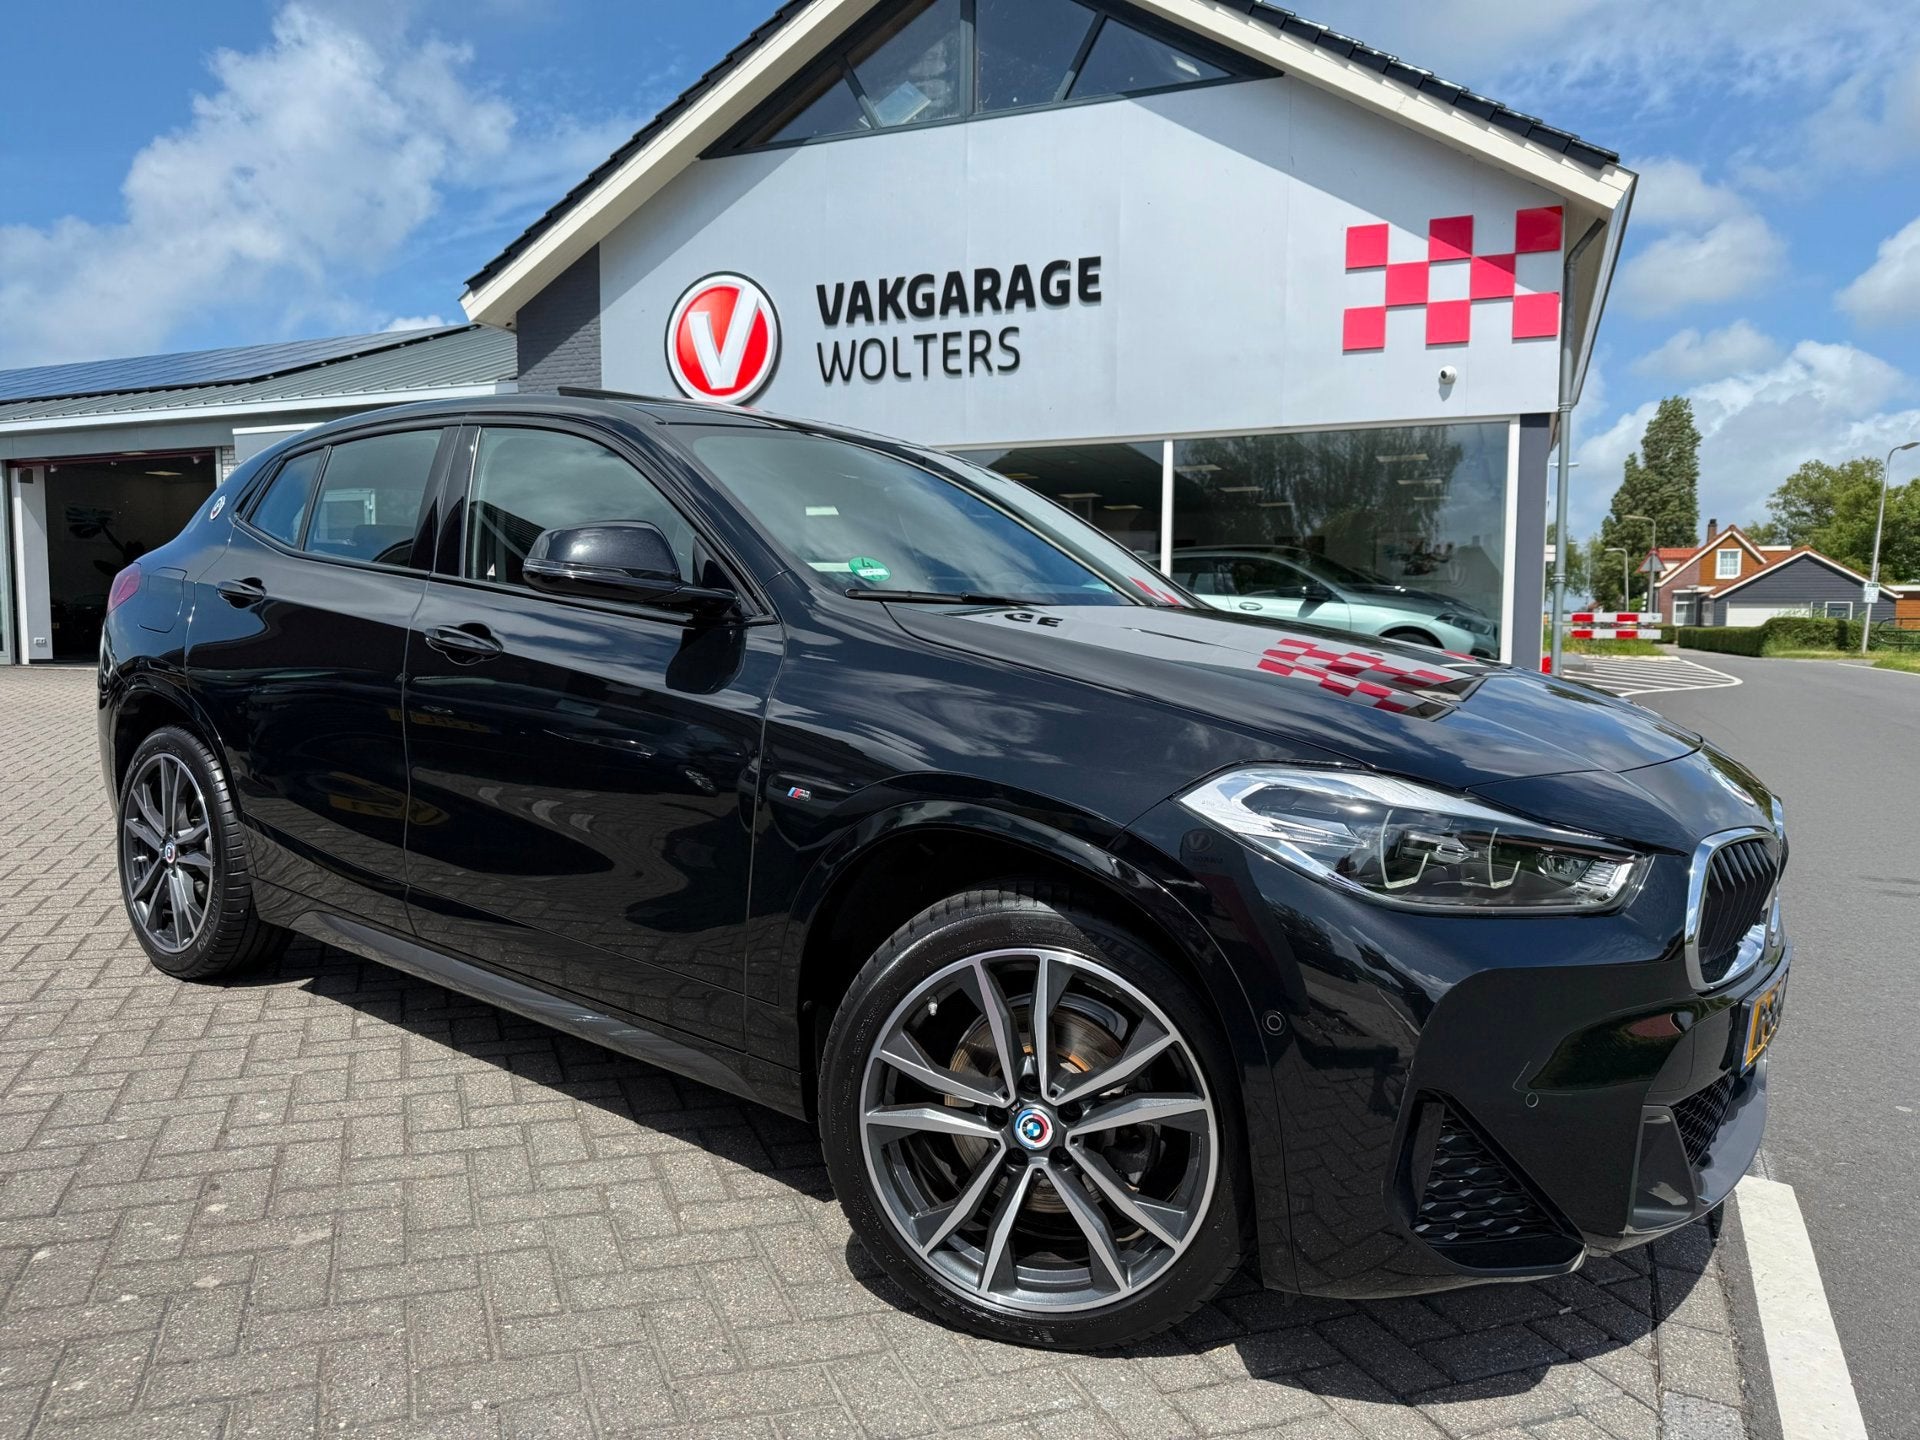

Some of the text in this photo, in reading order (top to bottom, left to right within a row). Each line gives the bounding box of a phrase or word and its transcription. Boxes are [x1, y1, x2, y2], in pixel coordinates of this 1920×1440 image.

[816, 255, 1102, 326] VAKGARAGE
[687, 285, 759, 390] V
[816, 326, 1021, 384] WOLTERS
